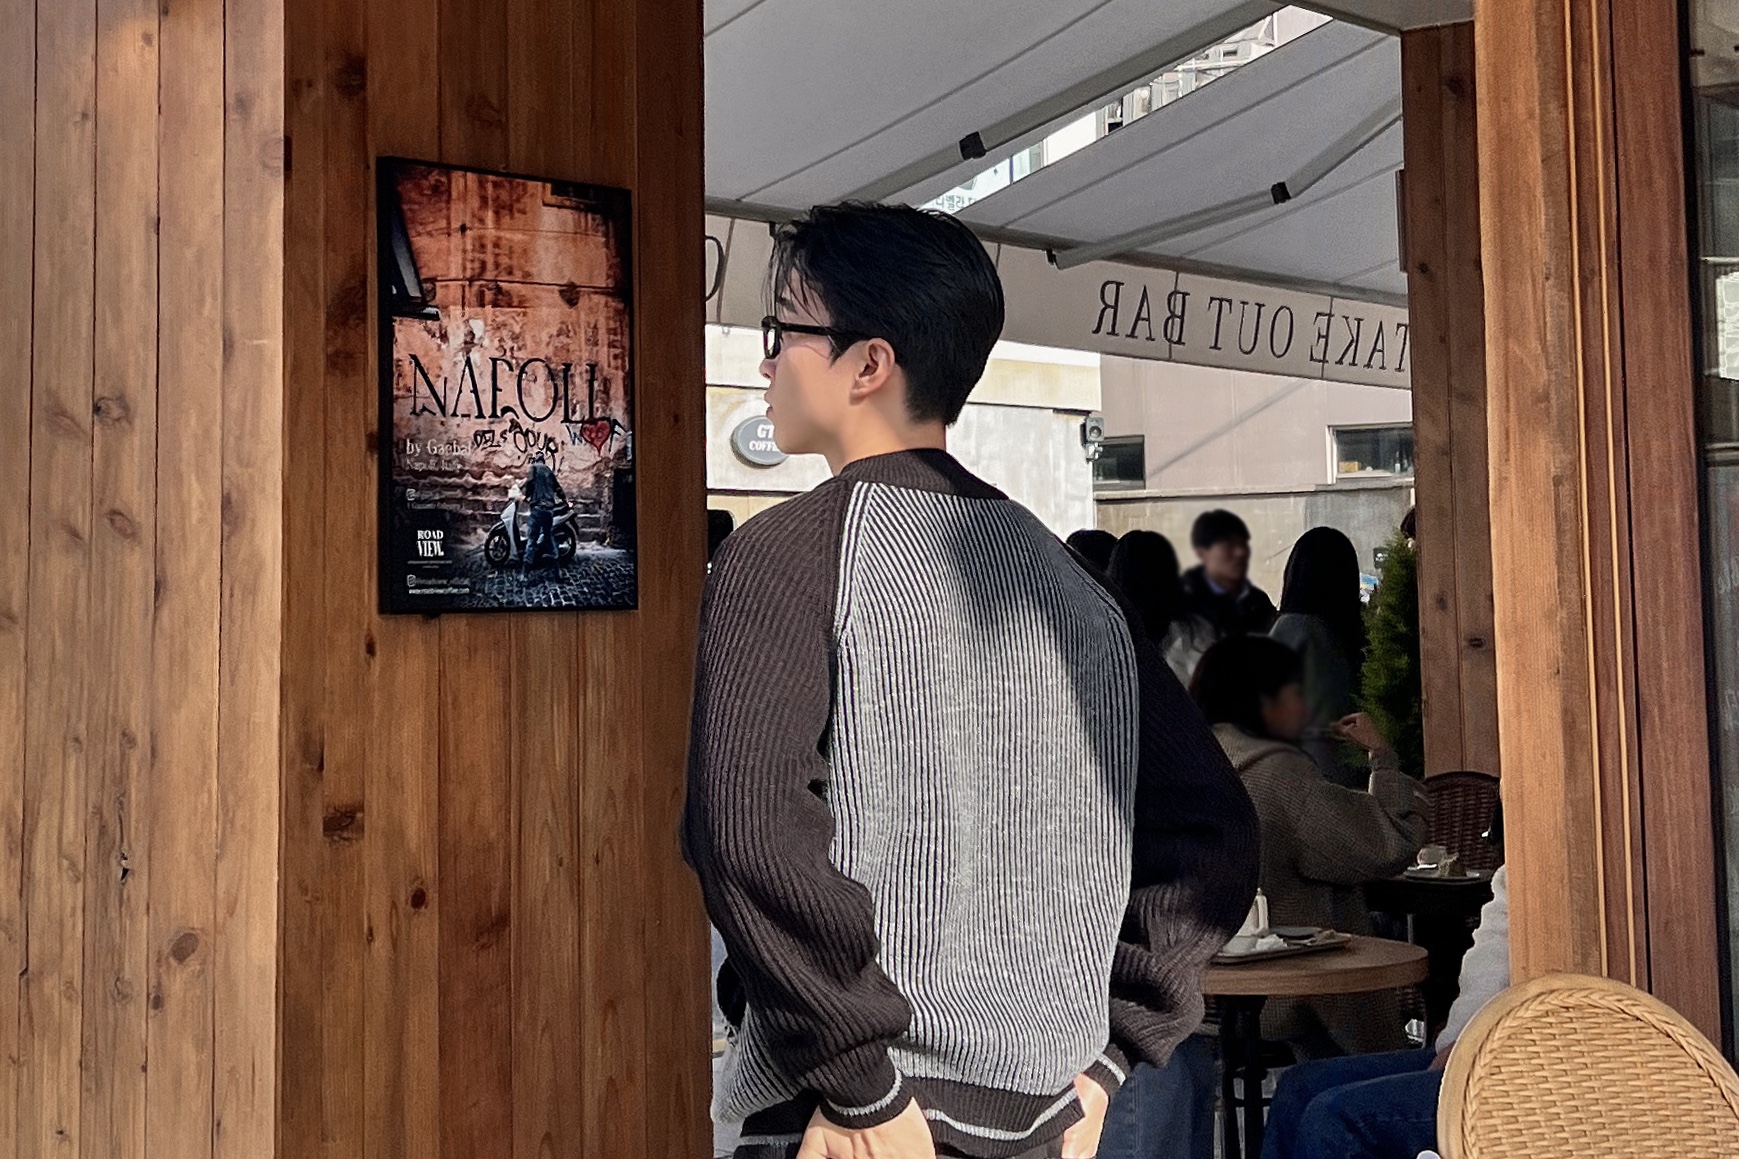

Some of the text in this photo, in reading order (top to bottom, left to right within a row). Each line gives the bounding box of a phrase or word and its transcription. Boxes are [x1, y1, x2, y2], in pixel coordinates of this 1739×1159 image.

[408, 353, 602, 423] NAPOLI
[406, 438, 421, 457] by
[417, 529, 444, 540] ROAD
